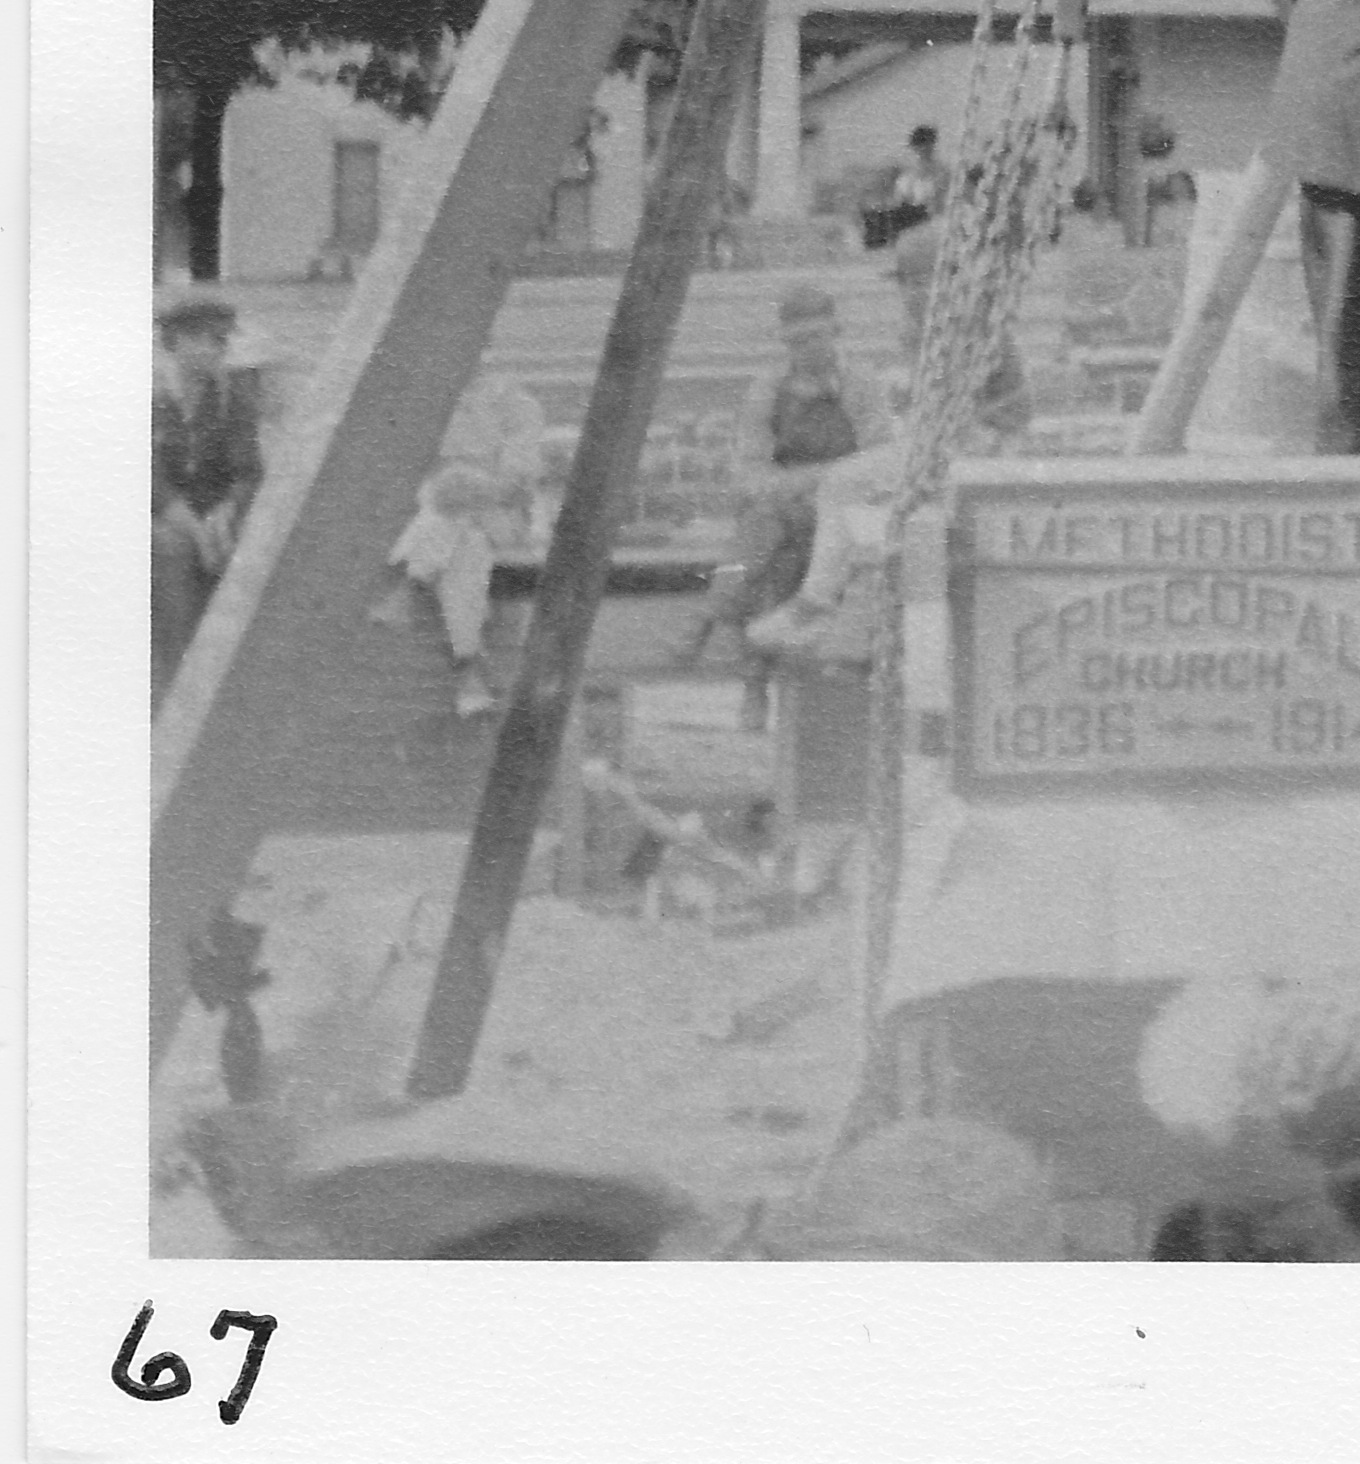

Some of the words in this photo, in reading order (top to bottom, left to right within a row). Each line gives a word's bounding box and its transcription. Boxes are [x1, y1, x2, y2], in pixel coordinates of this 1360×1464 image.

[1078, 649, 1289, 692] CHURCH
[992, 701, 1137, 760] 1836
[110, 1298, 279, 1426] 67
